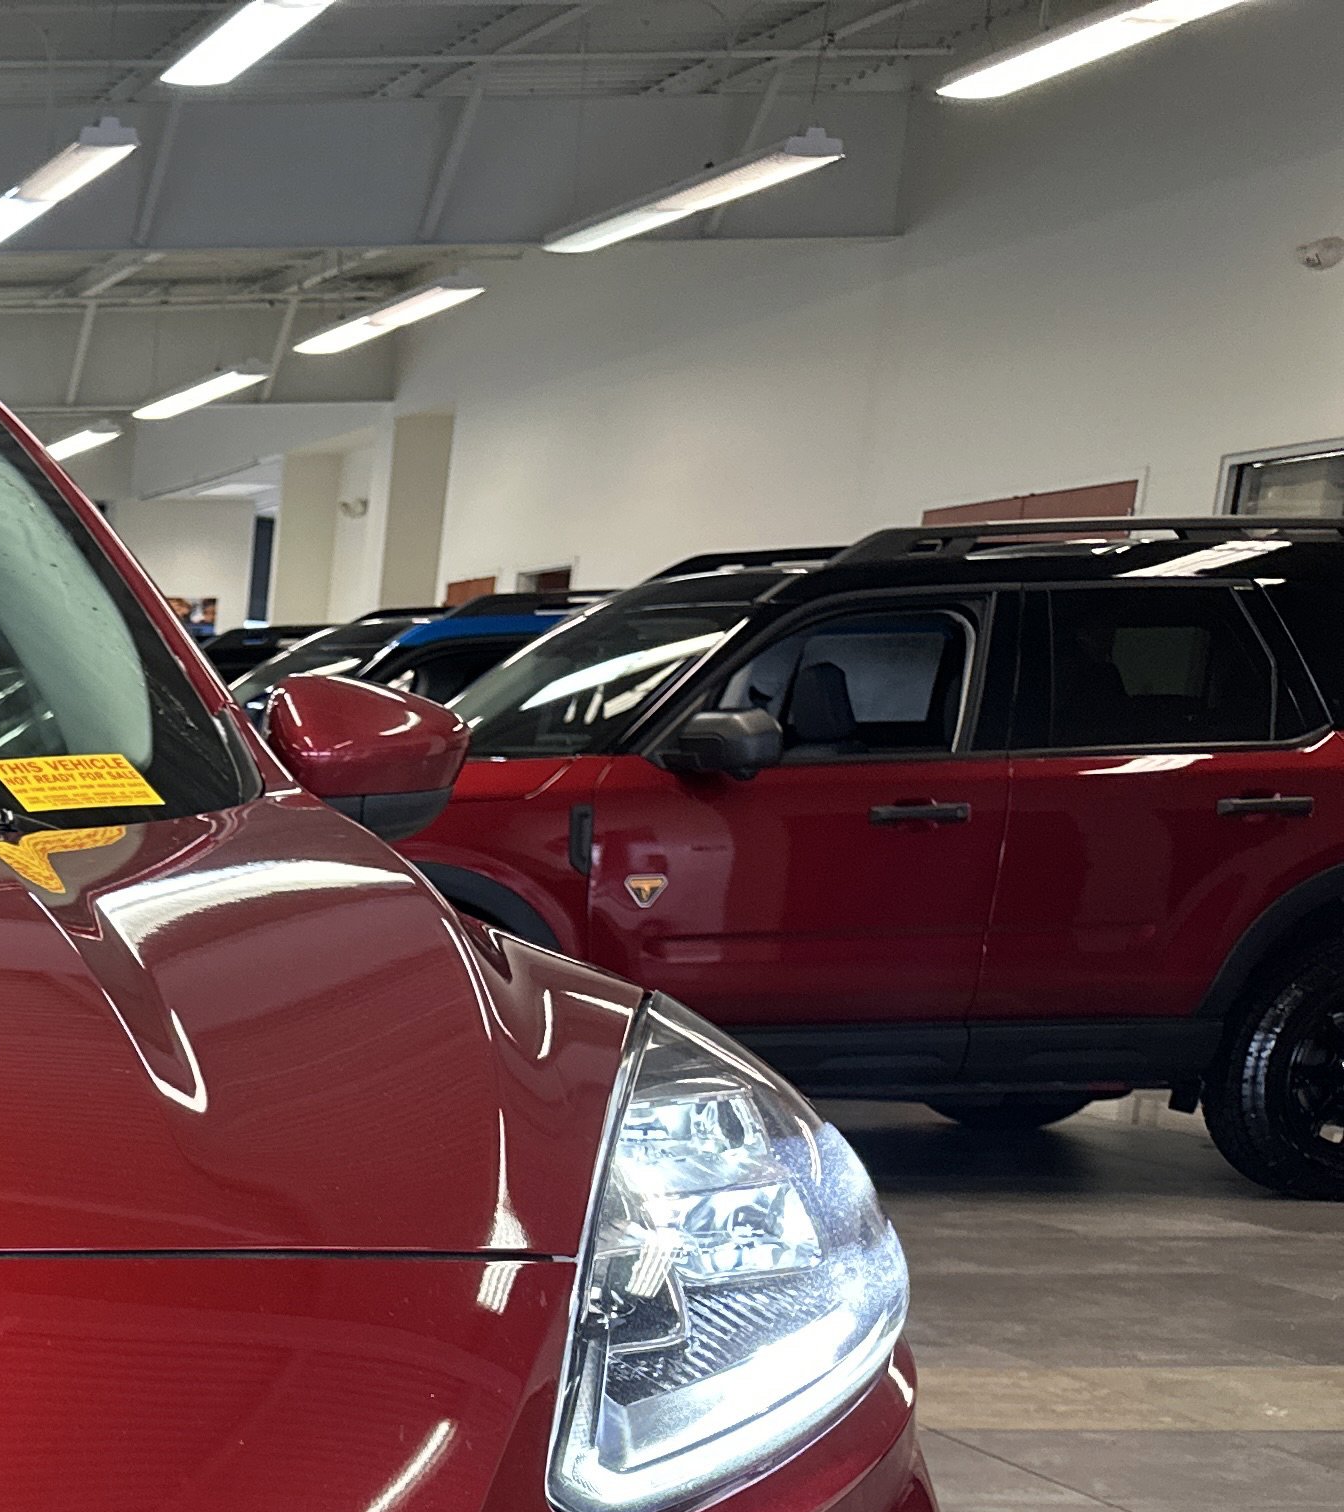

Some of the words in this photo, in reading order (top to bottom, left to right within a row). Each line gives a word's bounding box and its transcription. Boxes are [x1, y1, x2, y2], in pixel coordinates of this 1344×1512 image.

[44, 758, 129, 771] VEHICLE
[4, 775, 31, 785] NOT
[33, 774, 76, 783] READY
[78, 772, 106, 781] FOR
[106, 770, 141, 780] SALE
